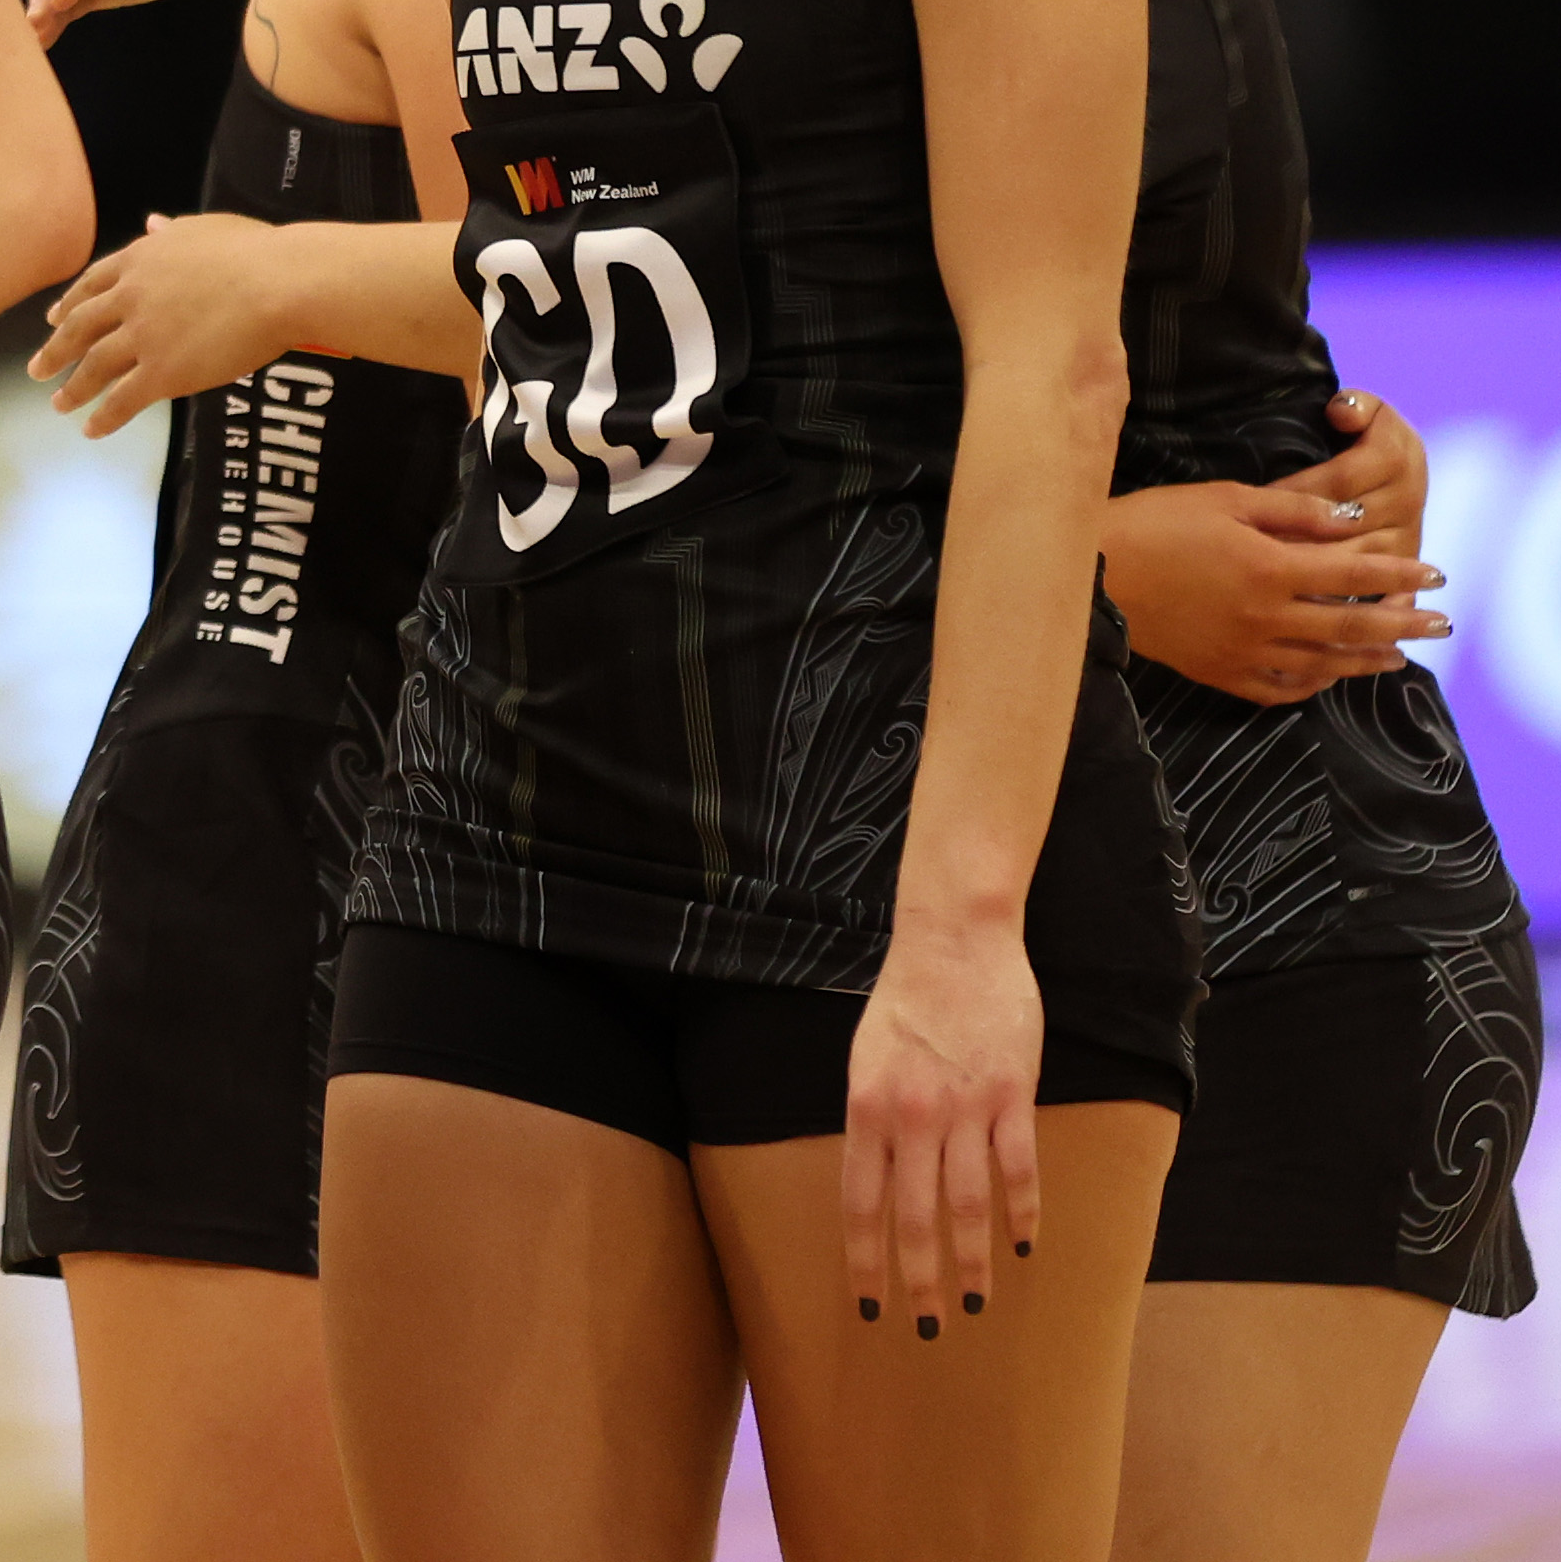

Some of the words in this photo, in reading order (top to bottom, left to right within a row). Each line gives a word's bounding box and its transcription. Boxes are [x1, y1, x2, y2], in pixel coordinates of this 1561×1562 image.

[456, 2, 621, 99] ANZ
[570, 166, 596, 186] WM
[570, 188, 598, 205] New
[599, 181, 660, 201] Zealand
[475, 225, 718, 553] GD
[229, 364, 334, 665] CHEMIST
